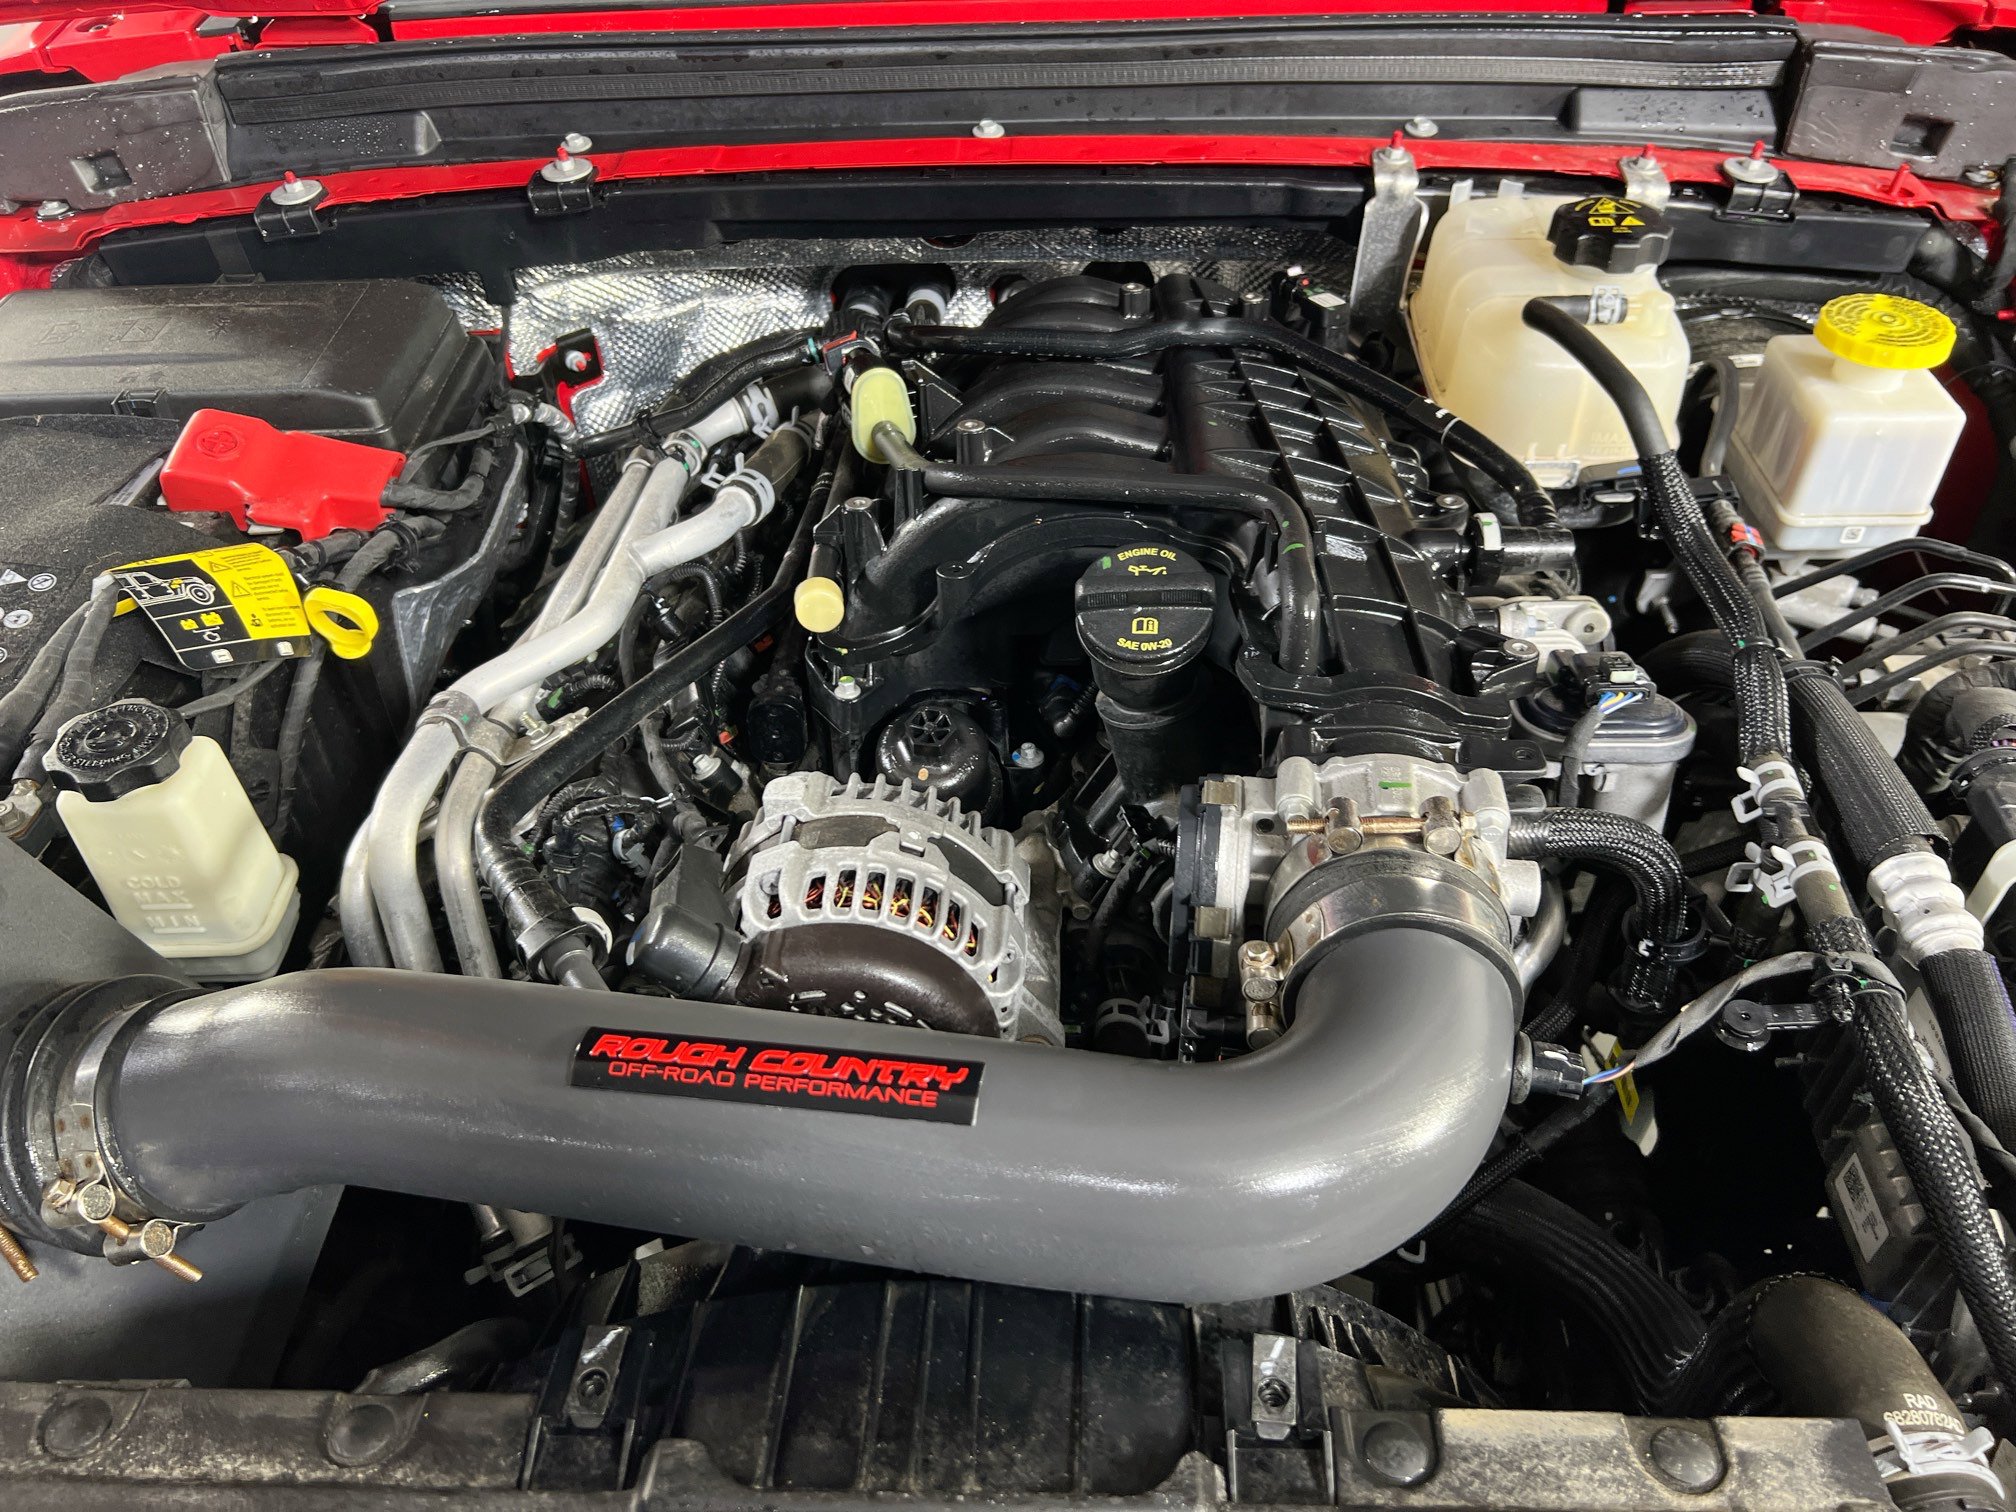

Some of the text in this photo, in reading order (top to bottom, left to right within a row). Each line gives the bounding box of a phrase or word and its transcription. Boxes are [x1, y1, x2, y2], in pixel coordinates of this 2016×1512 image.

[1117, 548, 1177, 561] ENGINE OIL
[1117, 638, 1172, 651] SAE 0W-20
[127, 876, 182, 889] COLD
[145, 914, 201, 929] MIN
[589, 1034, 968, 1090] ROUGH COUNTRY
[608, 1062, 938, 1107] OFF-ROAD PERFORMANCE
[1903, 1393, 1937, 1410] RAD
